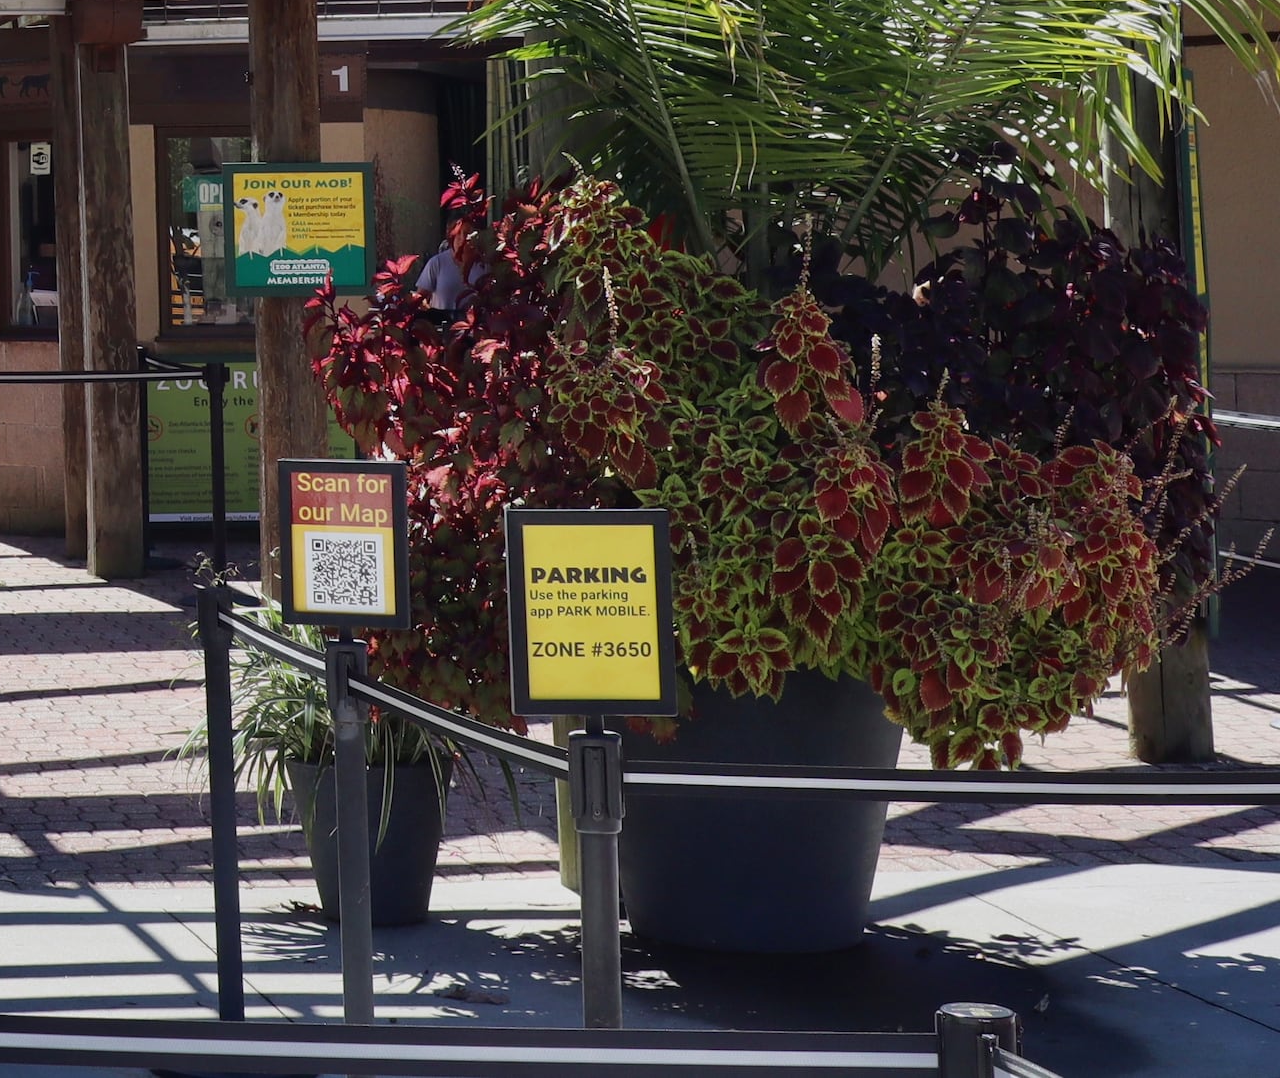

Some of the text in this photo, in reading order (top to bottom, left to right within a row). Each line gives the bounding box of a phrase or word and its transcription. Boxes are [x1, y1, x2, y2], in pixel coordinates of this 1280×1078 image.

[332, 66, 348, 91] 1
[244, 178, 352, 190] JOIN OUR MOB!
[233, 396, 253, 406] the
[297, 473, 388, 493] Scan for
[299, 503, 387, 527] our Map
[530, 567, 646, 583] PARKING
[530, 589, 628, 602] Use the parking
[530, 606, 650, 619] app PARK MOBILE.
[532, 642, 651, 657] ZONE #3650
